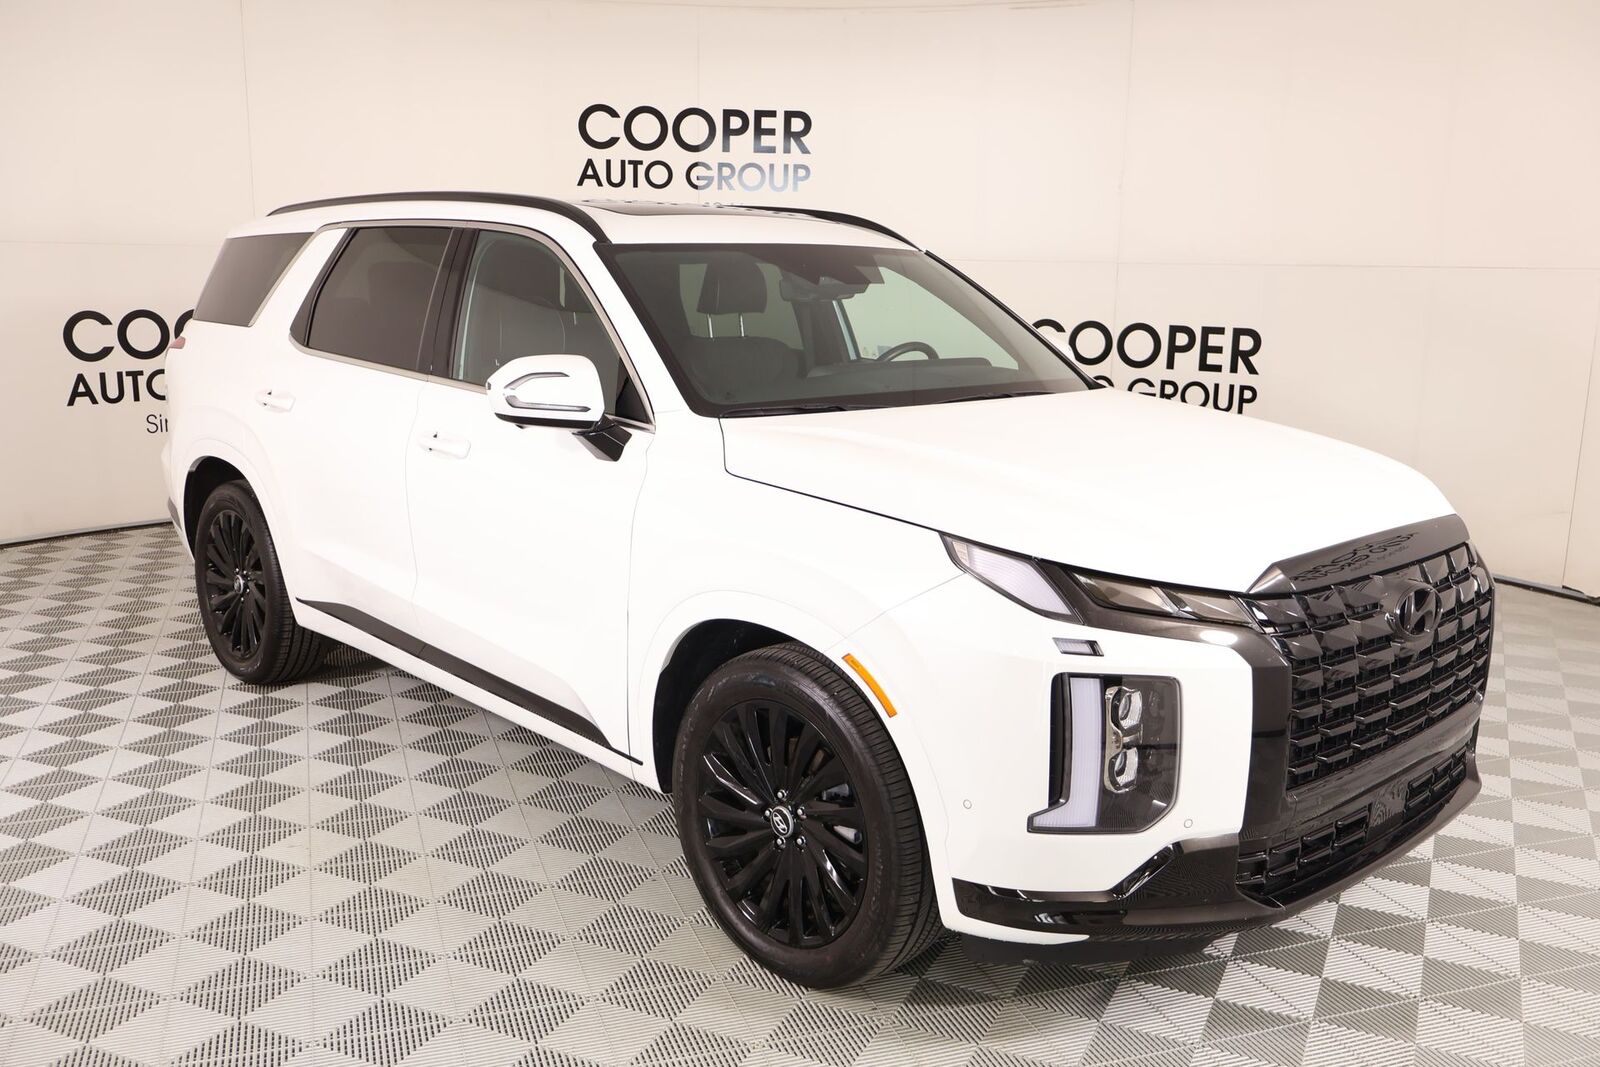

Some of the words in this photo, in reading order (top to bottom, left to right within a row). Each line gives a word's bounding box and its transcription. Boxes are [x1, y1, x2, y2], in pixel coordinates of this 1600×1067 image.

[578, 104, 812, 154] COOPER
[577, 158, 673, 189] AUTO
[685, 161, 811, 192] GROUP
[67, 369, 165, 406] AUTO
[1127, 378, 1258, 414] GROUP
